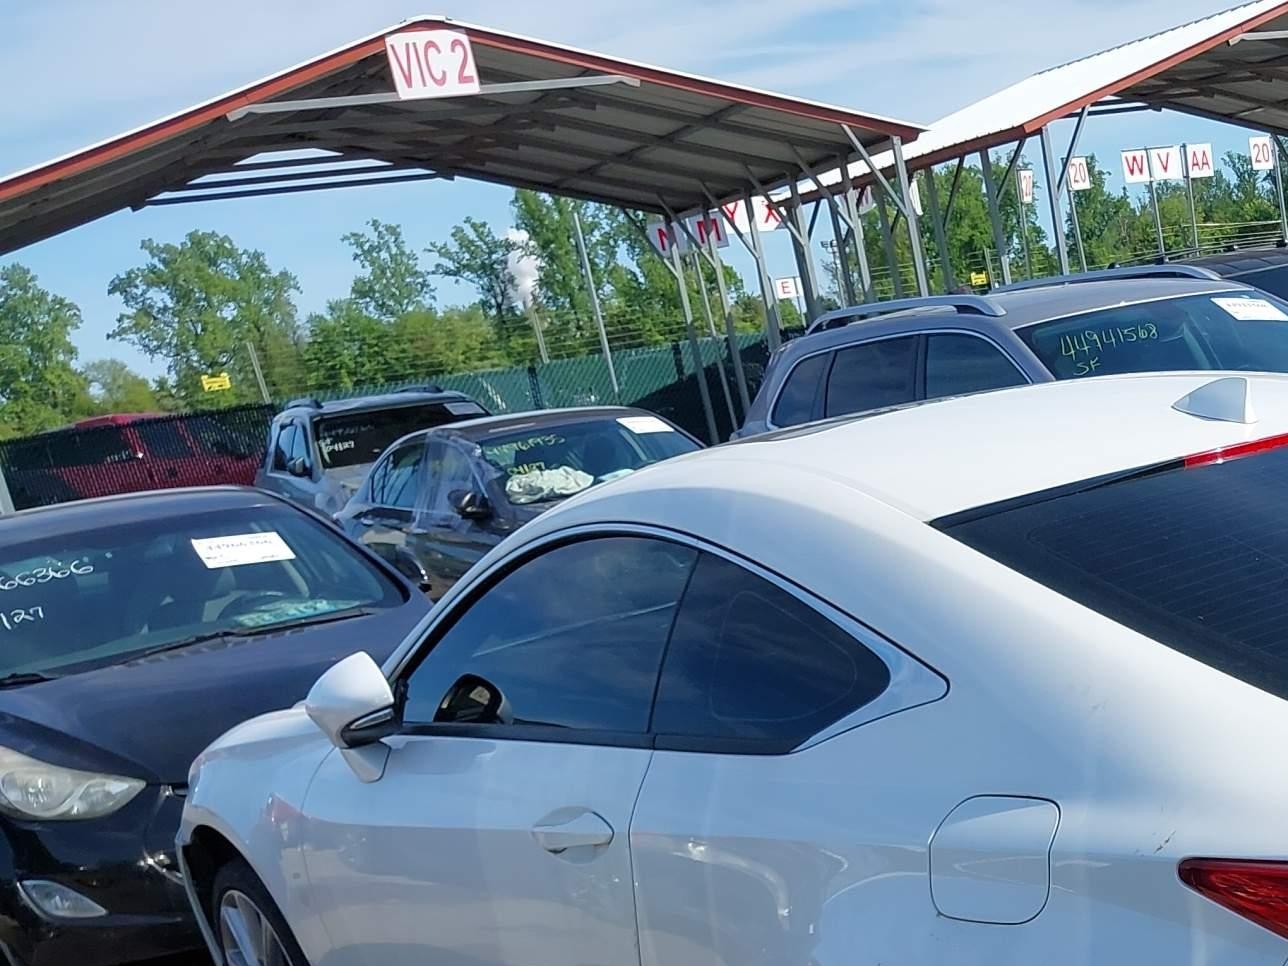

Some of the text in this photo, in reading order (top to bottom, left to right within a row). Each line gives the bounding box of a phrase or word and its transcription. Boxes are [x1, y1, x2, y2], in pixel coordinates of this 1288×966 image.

[389, 38, 475, 89] VIC 2
[1157, 152, 1170, 173] V
[1191, 150, 1211, 172] AA
[1253, 143, 1270, 164] 20
[1070, 162, 1087, 183] 20
[1125, 155, 1144, 176] W
[781, 280, 793, 294] E
[1060, 323, 1158, 361] 44941568
